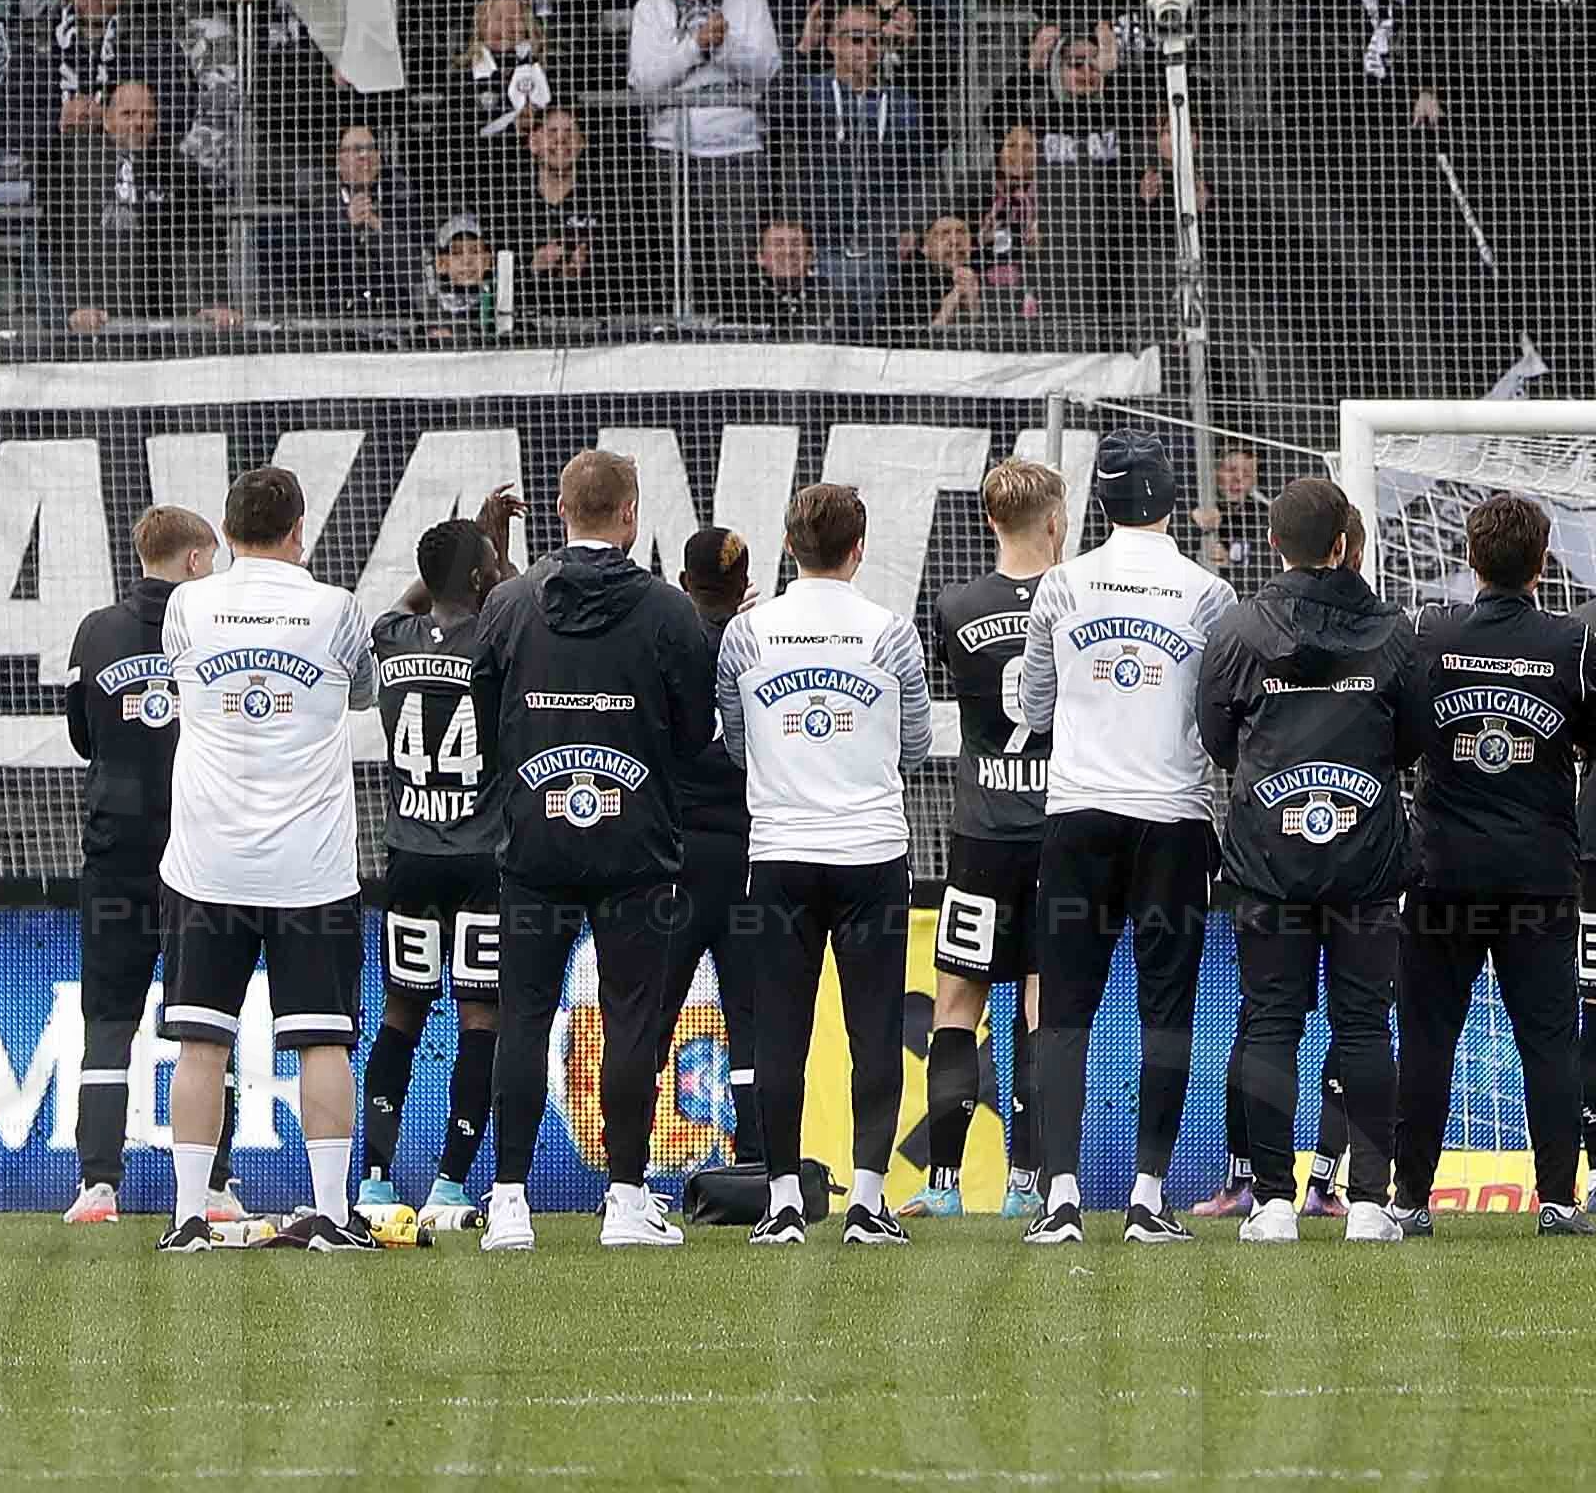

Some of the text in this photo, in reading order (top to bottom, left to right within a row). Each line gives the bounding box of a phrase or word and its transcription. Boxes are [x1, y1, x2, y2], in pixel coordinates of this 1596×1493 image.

[1073, 617, 1189, 663] PUNTIGAMER
[200, 648, 319, 686] PUNTIGAMER
[758, 668, 879, 707] PUNTIGAMER
[1434, 691, 1559, 732] PUNTIGAMER
[393, 693, 484, 786] 44
[523, 748, 644, 788] PUNTIGAMER
[1263, 763, 1375, 803] PUNTIGAMER
[399, 784, 479, 823] DANTE
